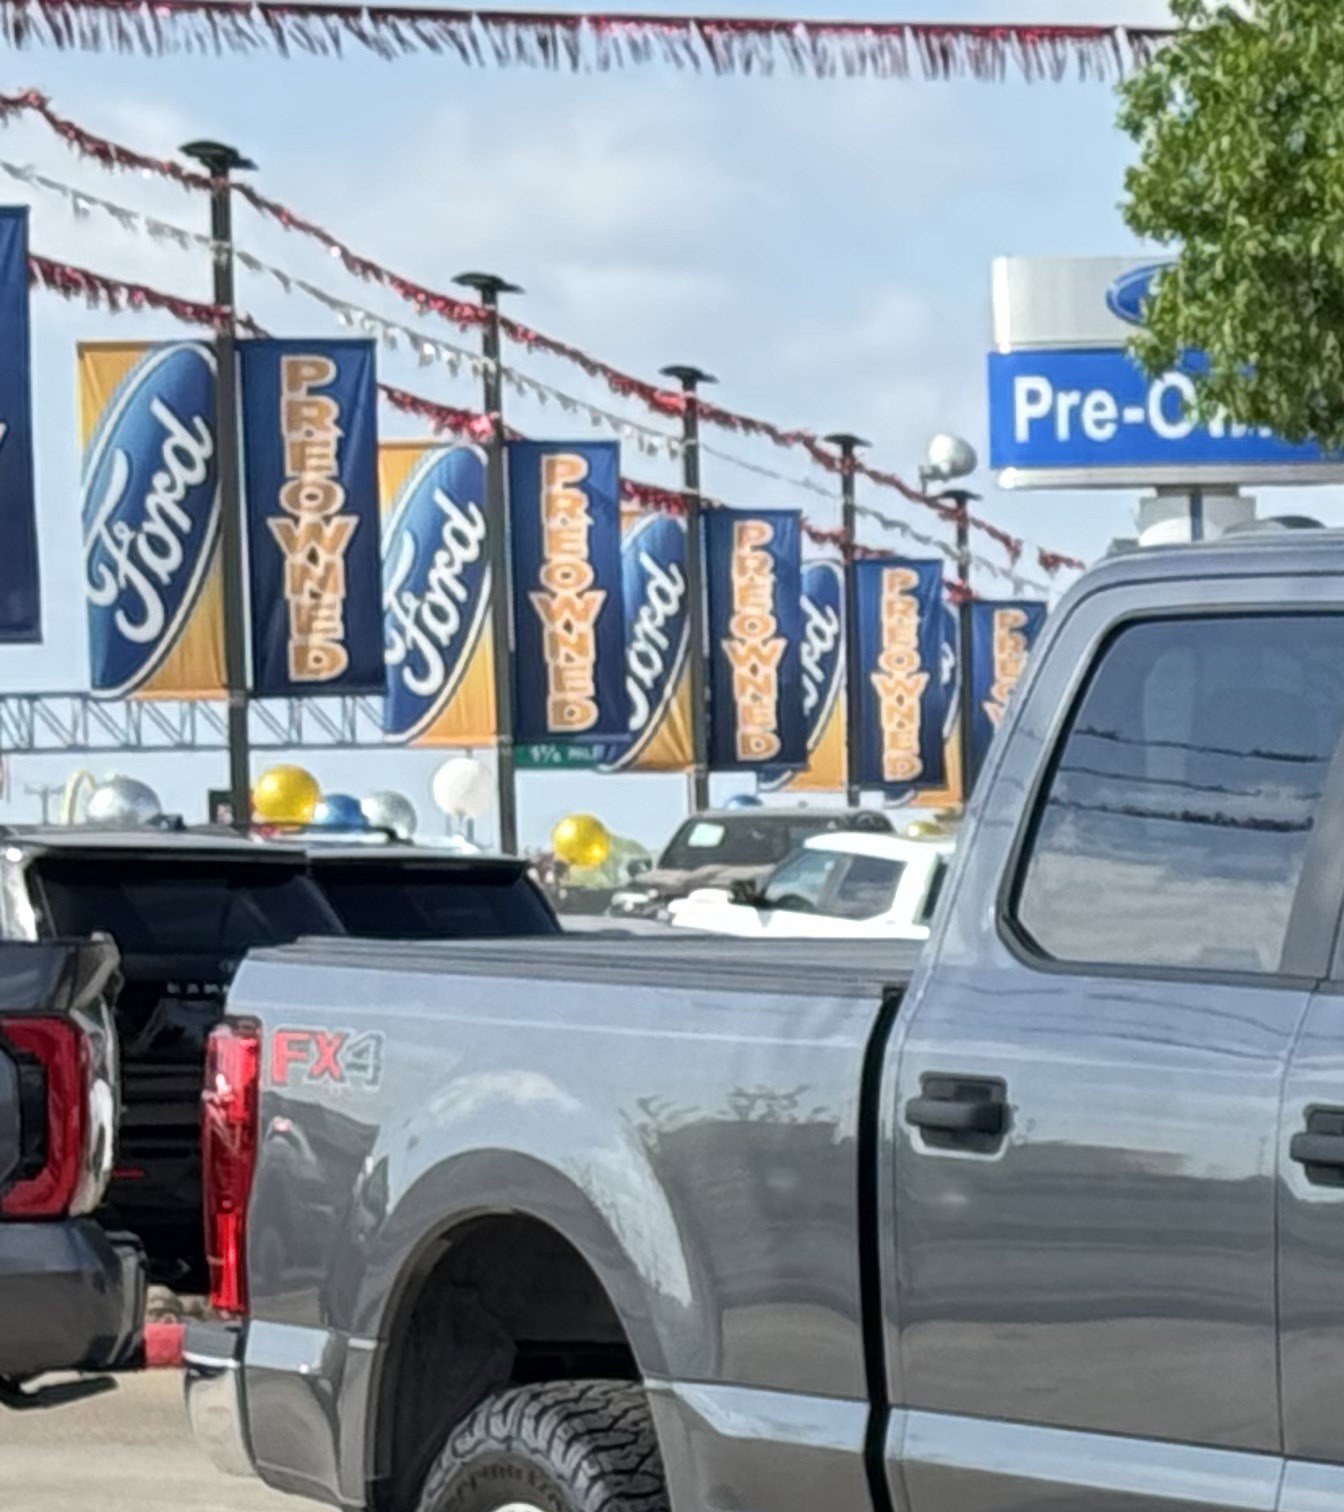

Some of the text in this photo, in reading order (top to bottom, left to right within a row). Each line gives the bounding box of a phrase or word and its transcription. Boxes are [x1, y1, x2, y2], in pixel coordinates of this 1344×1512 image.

[85, 400, 213, 644] Ford
[267, 353, 357, 683] PREOWNED
[1013, 371, 1273, 445] Pre-O
[384, 487, 486, 697] Ford
[527, 453, 607, 732] PREOWNED
[721, 518, 787, 761] PREOWNED
[269, 1028, 385, 1091] FX4
